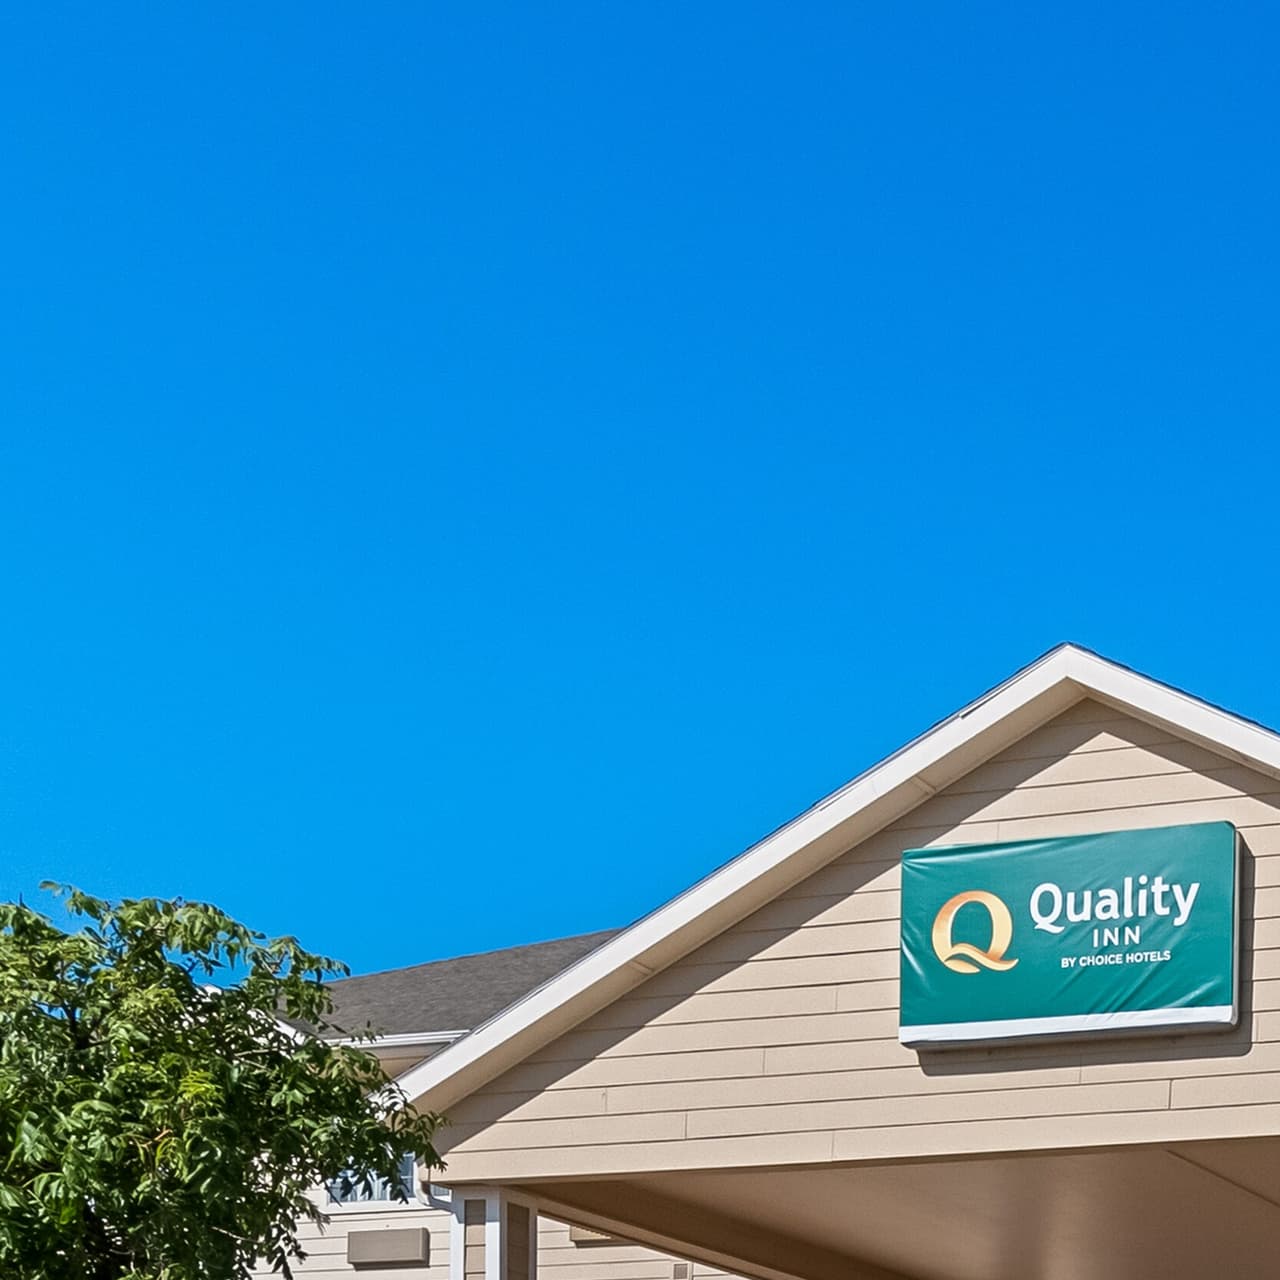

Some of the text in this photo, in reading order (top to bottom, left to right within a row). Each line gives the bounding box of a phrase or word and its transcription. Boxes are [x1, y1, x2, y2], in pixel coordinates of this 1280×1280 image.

[1029, 875, 1200, 934] Quality
[931, 890, 1019, 974] Q
[1092, 926, 1141, 948] INN
[1061, 950, 1171, 968] BY CHOICE HOTELS
